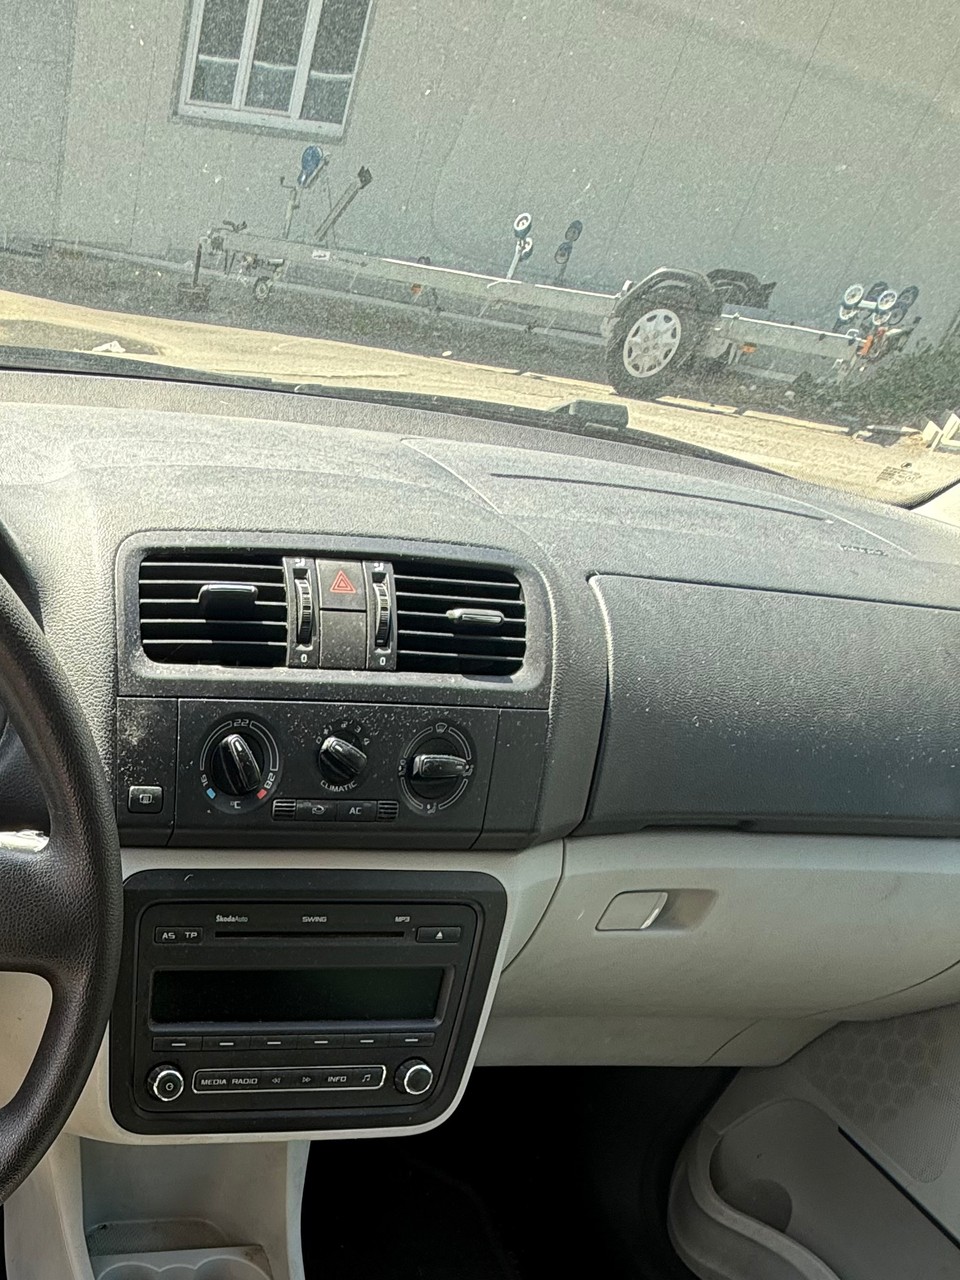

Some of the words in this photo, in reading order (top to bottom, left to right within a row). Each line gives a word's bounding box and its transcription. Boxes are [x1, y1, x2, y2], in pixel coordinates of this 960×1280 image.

[233, 718, 250, 727] 22
[263, 771, 276, 789] 28
[320, 779, 358, 792] CLIMATIC
[348, 806, 362, 815] AC
[162, 932, 176, 940] AS
[184, 931, 198, 939] TP
[200, 1078, 227, 1087] MEDIA
[231, 1077, 258, 1086] RADIO
[327, 1075, 347, 1084] INFO
